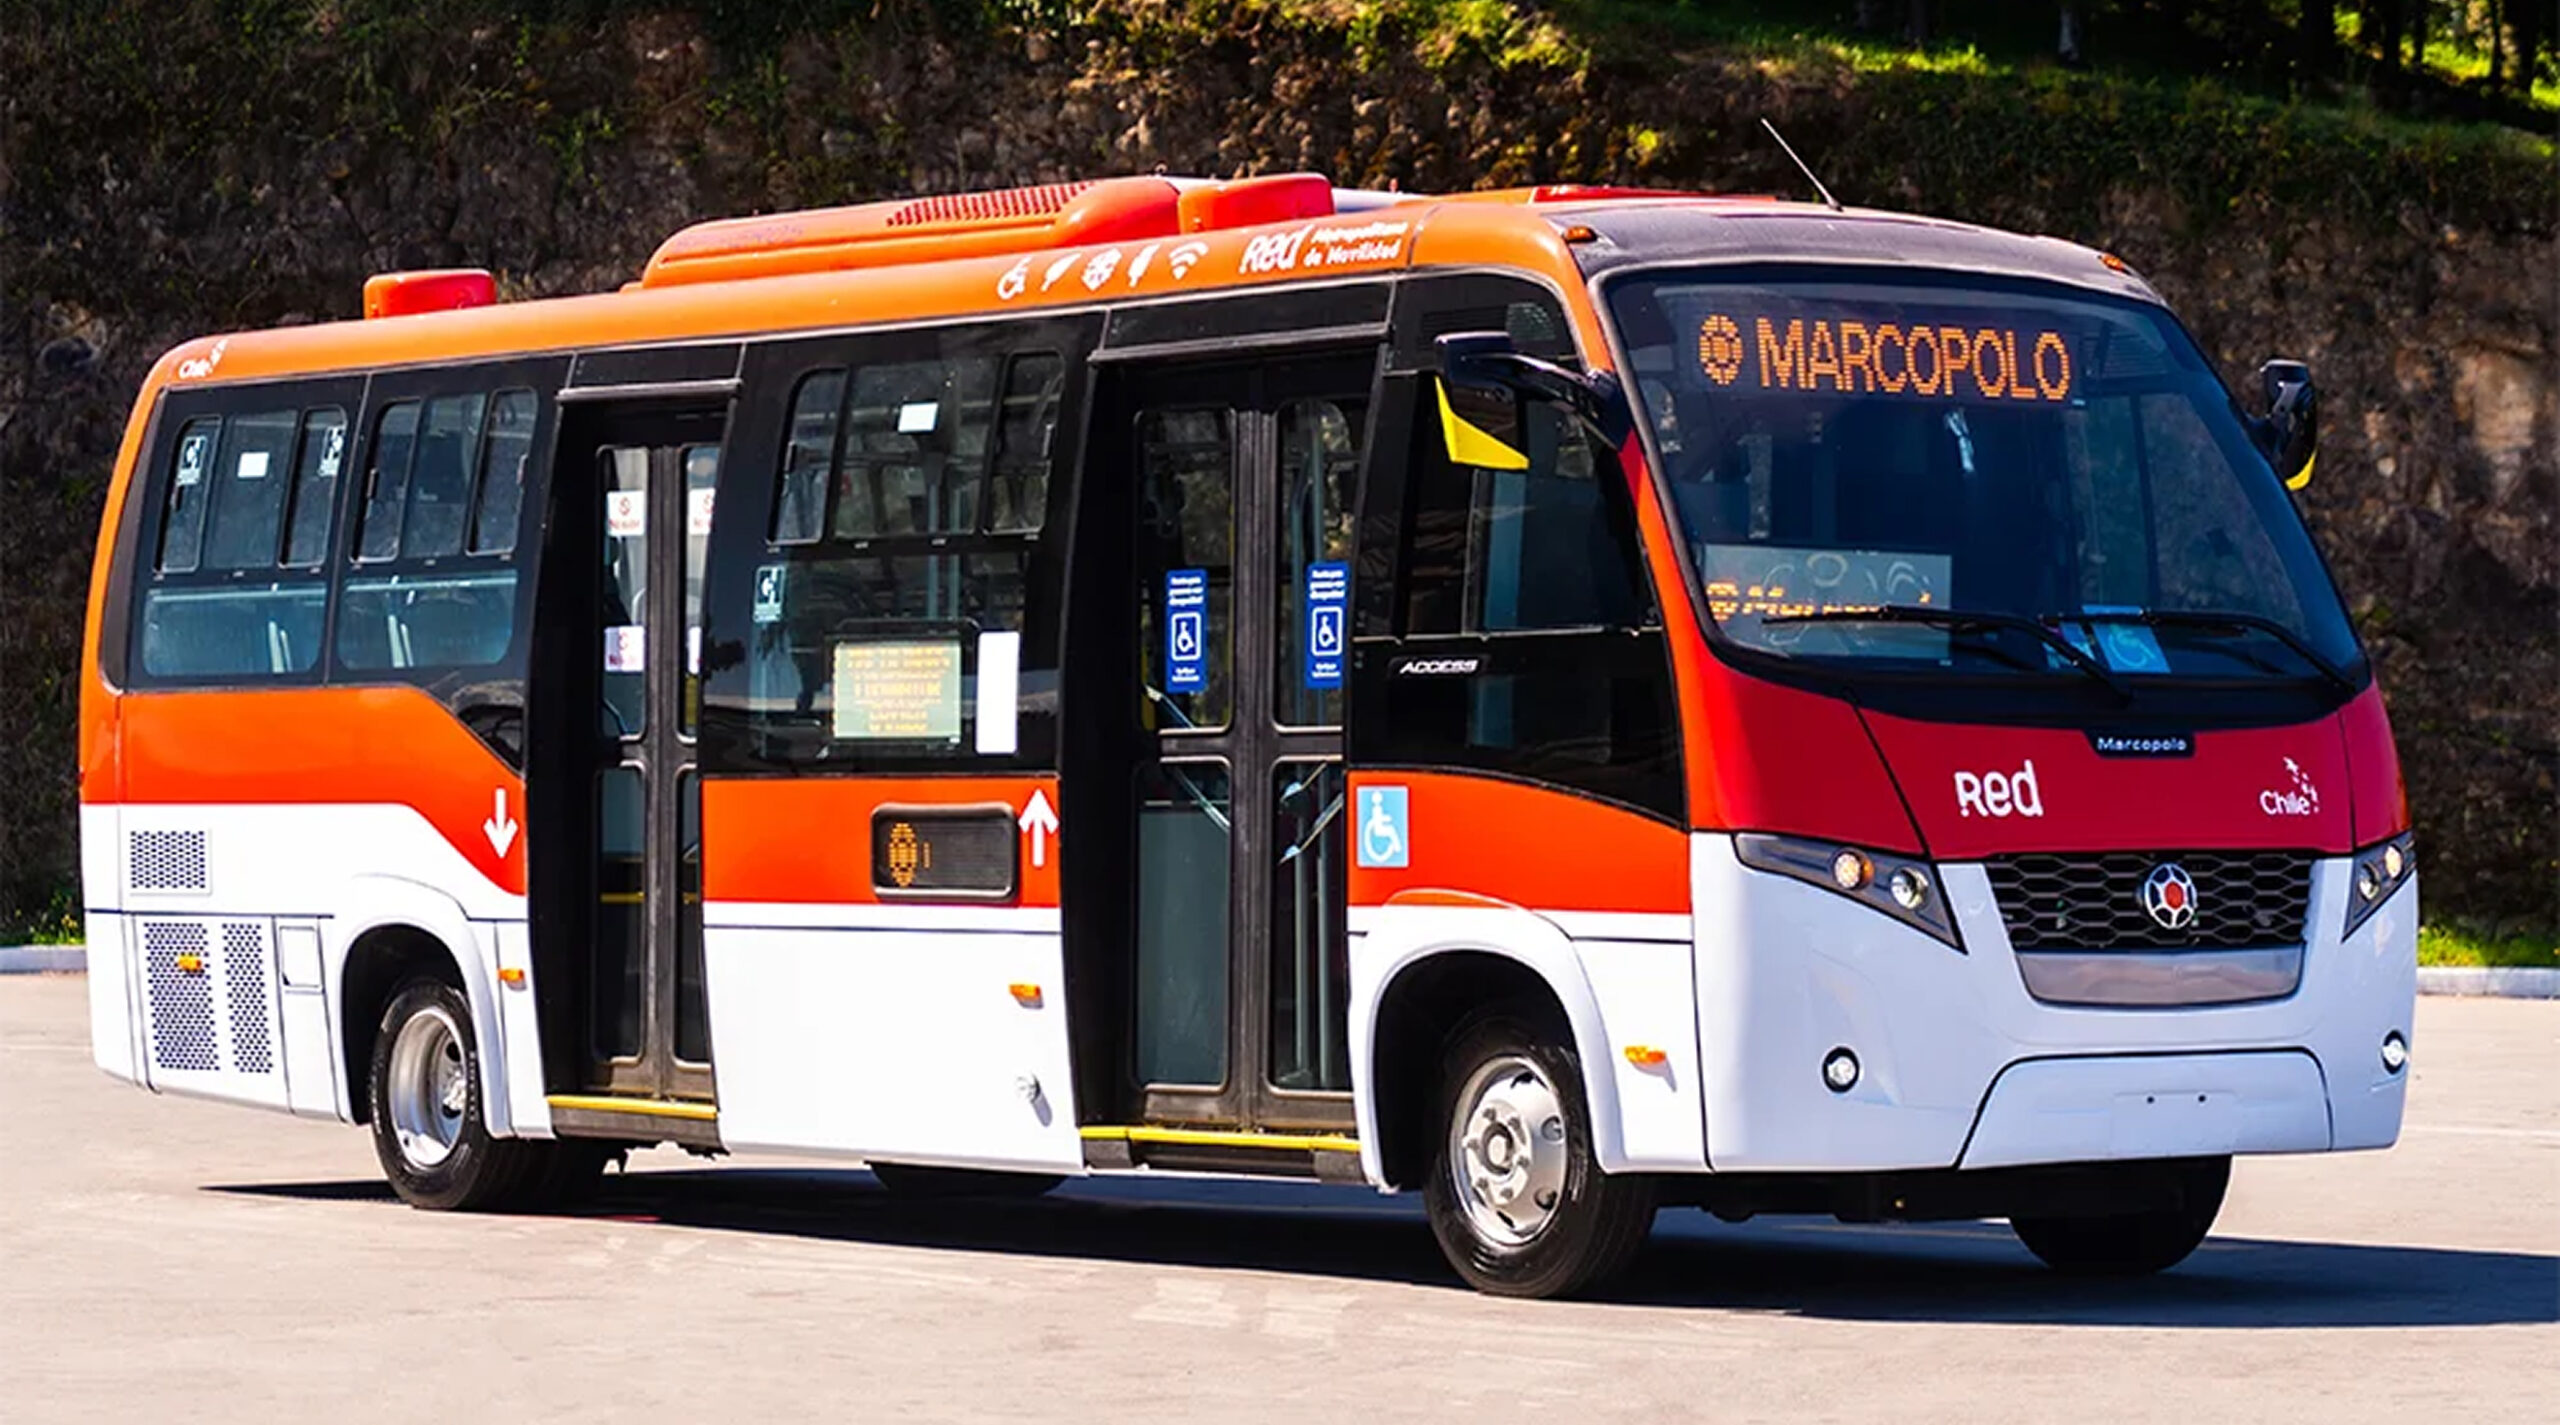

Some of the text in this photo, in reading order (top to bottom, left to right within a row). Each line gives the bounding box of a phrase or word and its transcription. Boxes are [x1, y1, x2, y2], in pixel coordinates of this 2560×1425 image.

[1238, 224, 1315, 274] Red
[1756, 317, 2070, 400] MARCOPOLO
[1399, 659, 1479, 674] ACCESS
[2097, 736, 2187, 752] Marcopolo
[1953, 758, 2045, 818] Red
